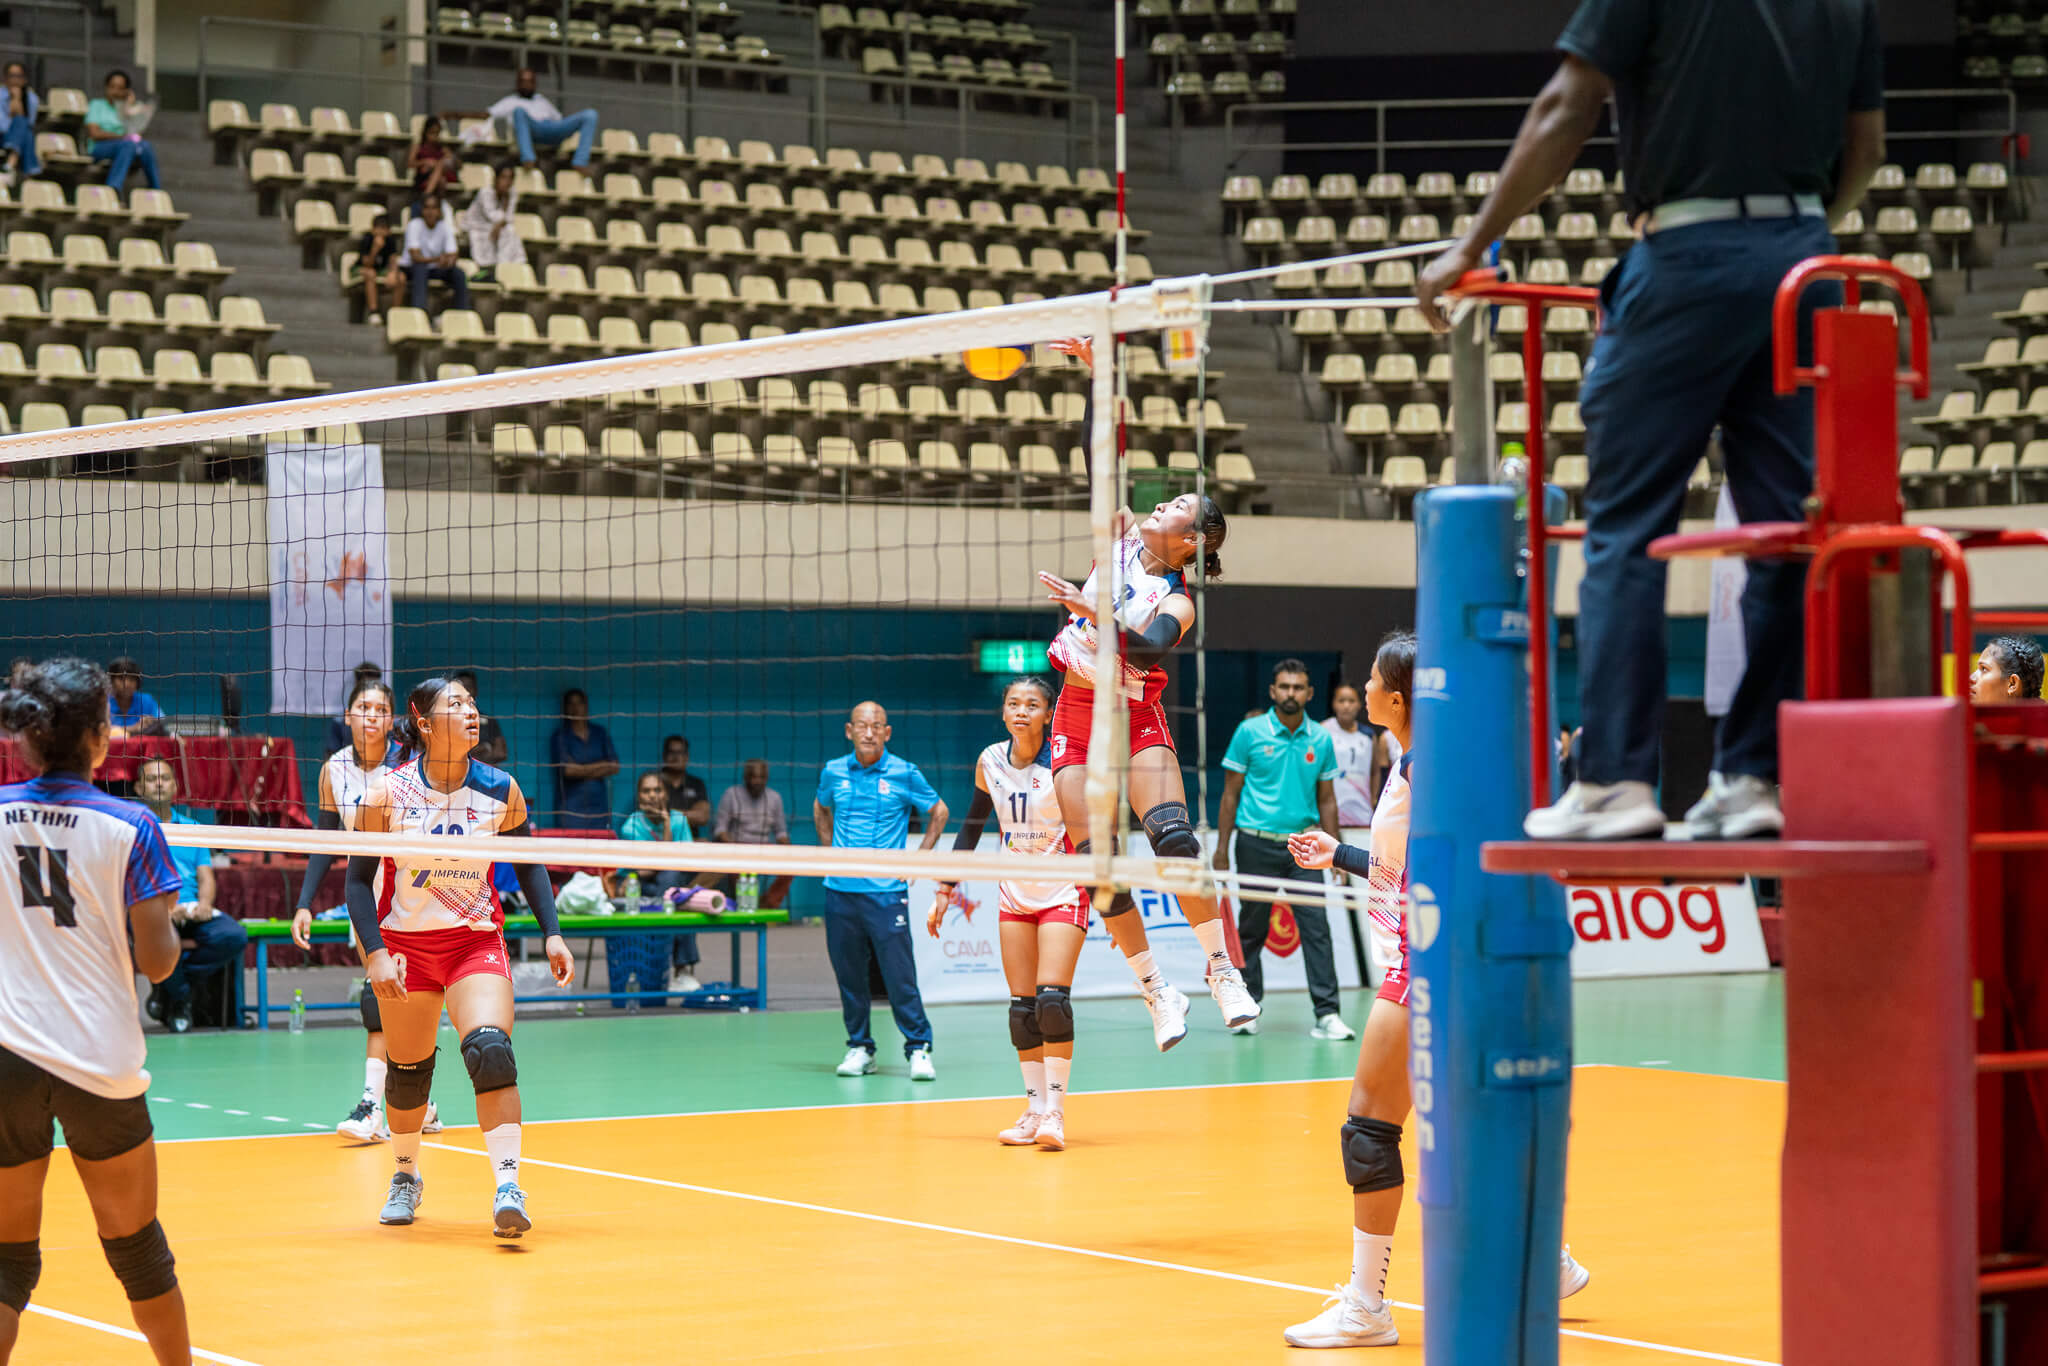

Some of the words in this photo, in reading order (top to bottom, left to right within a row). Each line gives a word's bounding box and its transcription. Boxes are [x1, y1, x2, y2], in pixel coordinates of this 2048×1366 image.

[5, 809, 79, 829] NETHMI
[1008, 792, 1028, 824] 17
[14, 844, 77, 927] 4
[434, 869, 480, 880] IMPERIAL
[1140, 889, 1186, 917] FI
[1571, 885, 1726, 954] alog
[943, 940, 994, 958] CAVA
[1411, 977, 1435, 1151] senoh
